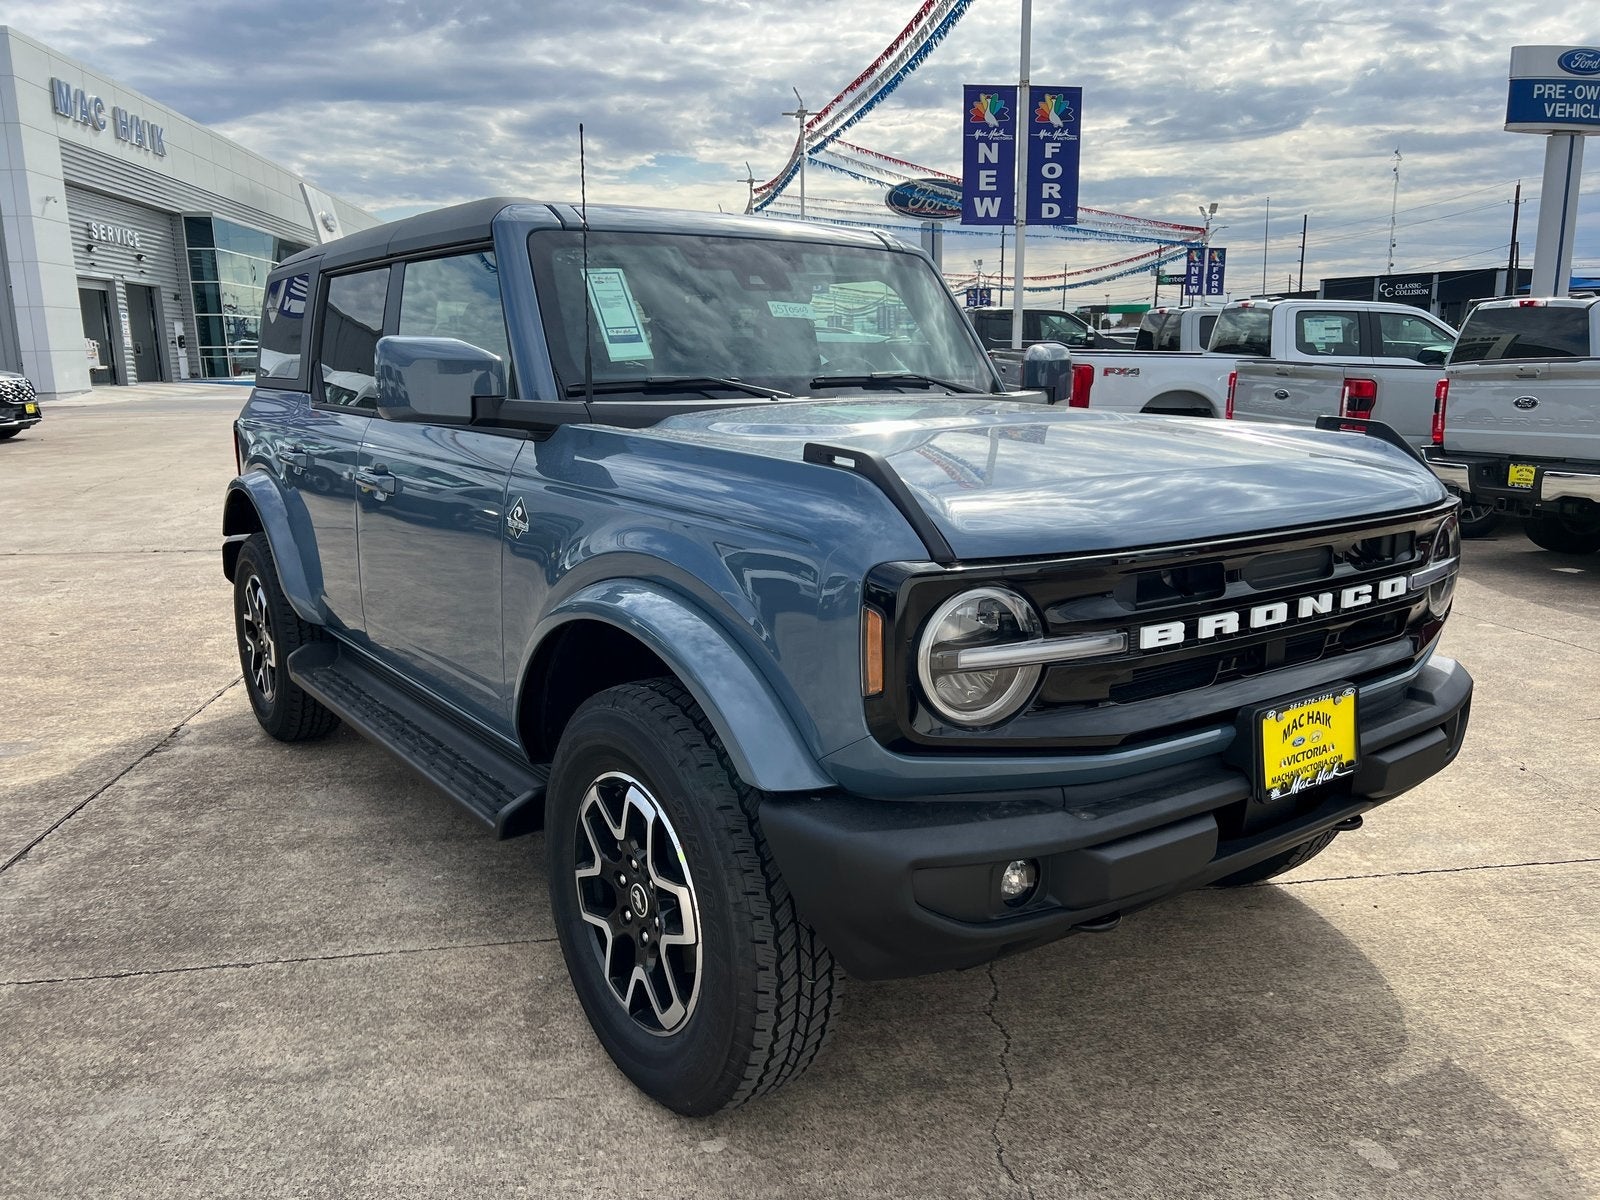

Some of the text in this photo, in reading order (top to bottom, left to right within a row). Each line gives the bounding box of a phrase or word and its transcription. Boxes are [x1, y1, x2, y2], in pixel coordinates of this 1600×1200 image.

[1570, 52, 1600, 69] Ford
[1533, 84, 1600, 100] PRE-OW
[51, 77, 166, 157] MAC HAIK
[1544, 102, 1600, 118] VEHICL
[973, 142, 1001, 217] NEW
[1041, 142, 1063, 218] FORD
[91, 222, 141, 247] SERVICE
[1189, 266, 1199, 293] NEW
[1211, 267, 1219, 294] FORD
[1395, 282, 1422, 290] CLASSIC
[1395, 288, 1429, 296] COLLISION
[1103, 367, 1140, 377] FX4
[1140, 576, 1407, 650] BRONCO
[1282, 710, 1332, 744] MAC HAIK
[1286, 744, 1328, 766] VICTORIA
